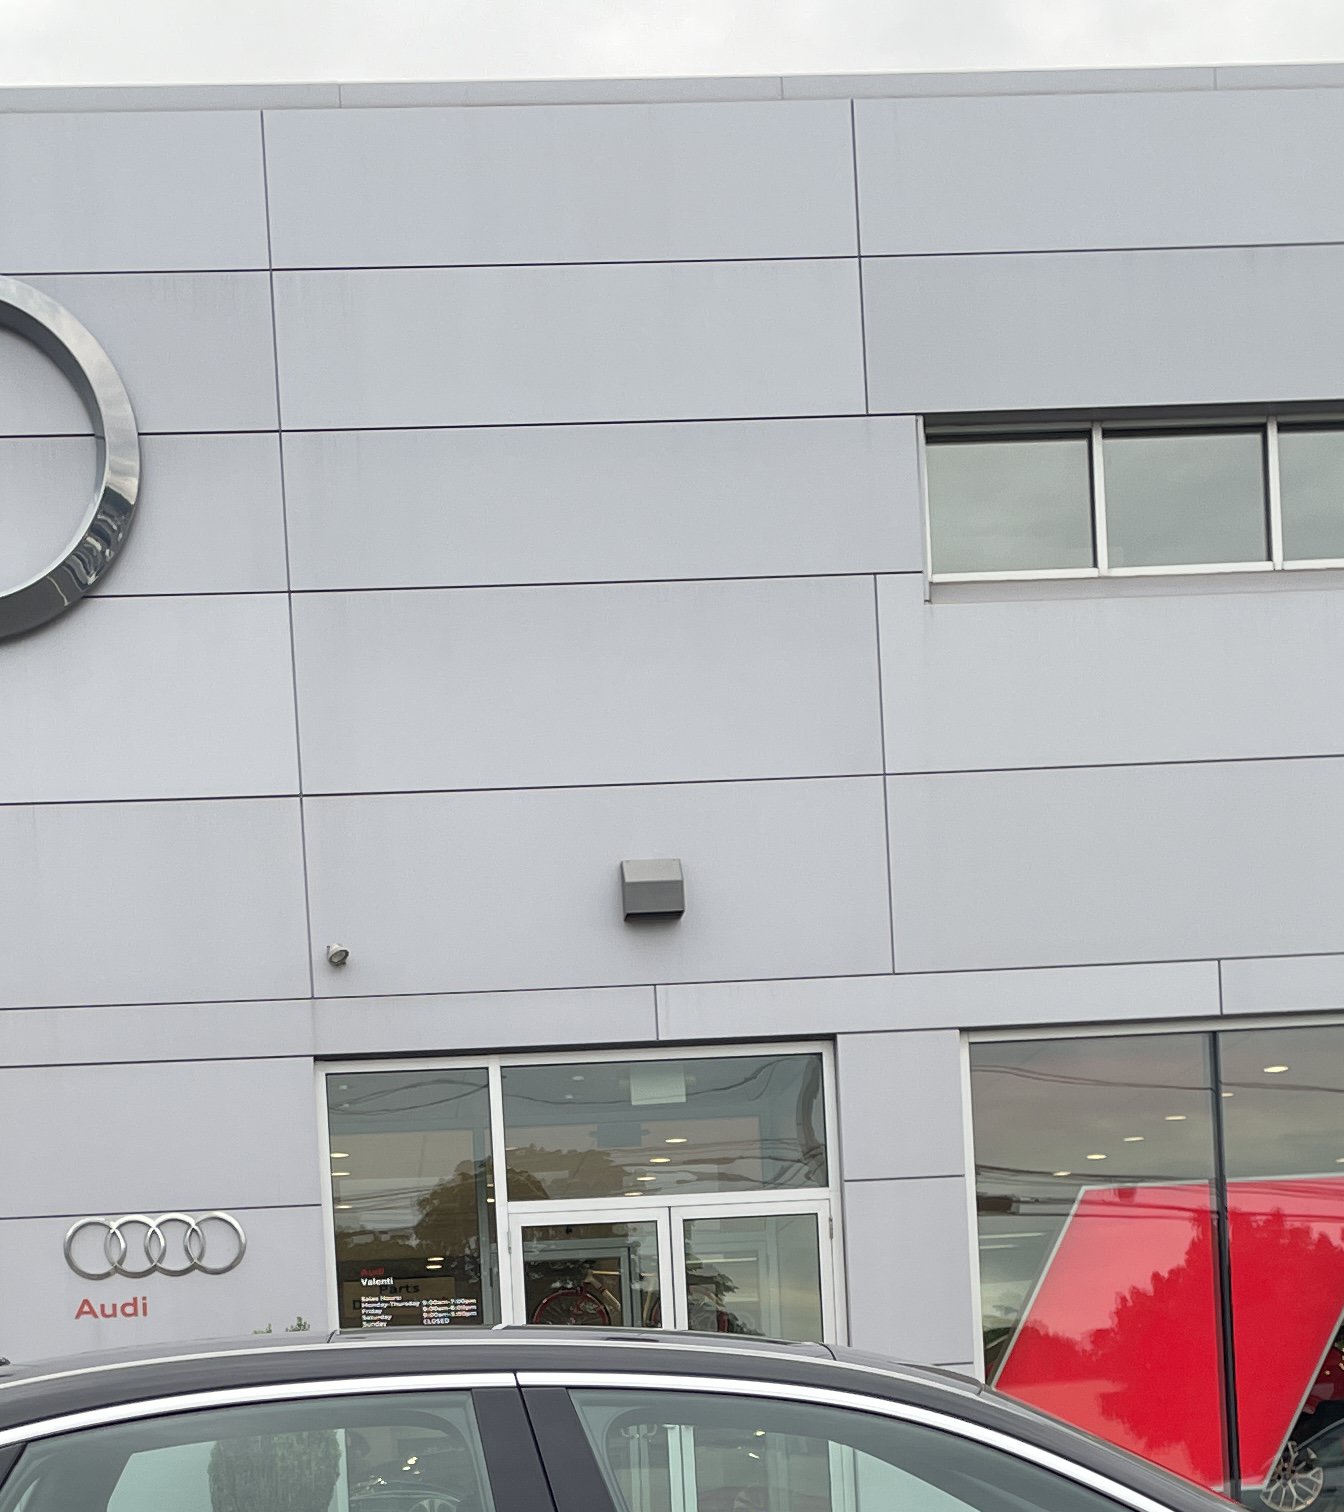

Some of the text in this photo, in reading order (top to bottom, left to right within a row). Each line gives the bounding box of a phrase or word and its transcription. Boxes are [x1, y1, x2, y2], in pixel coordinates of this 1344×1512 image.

[360, 1267, 385, 1277] Audi
[360, 1276, 394, 1286] Valenti
[379, 1284, 420, 1294] Parts
[75, 1296, 150, 1320] Audi
